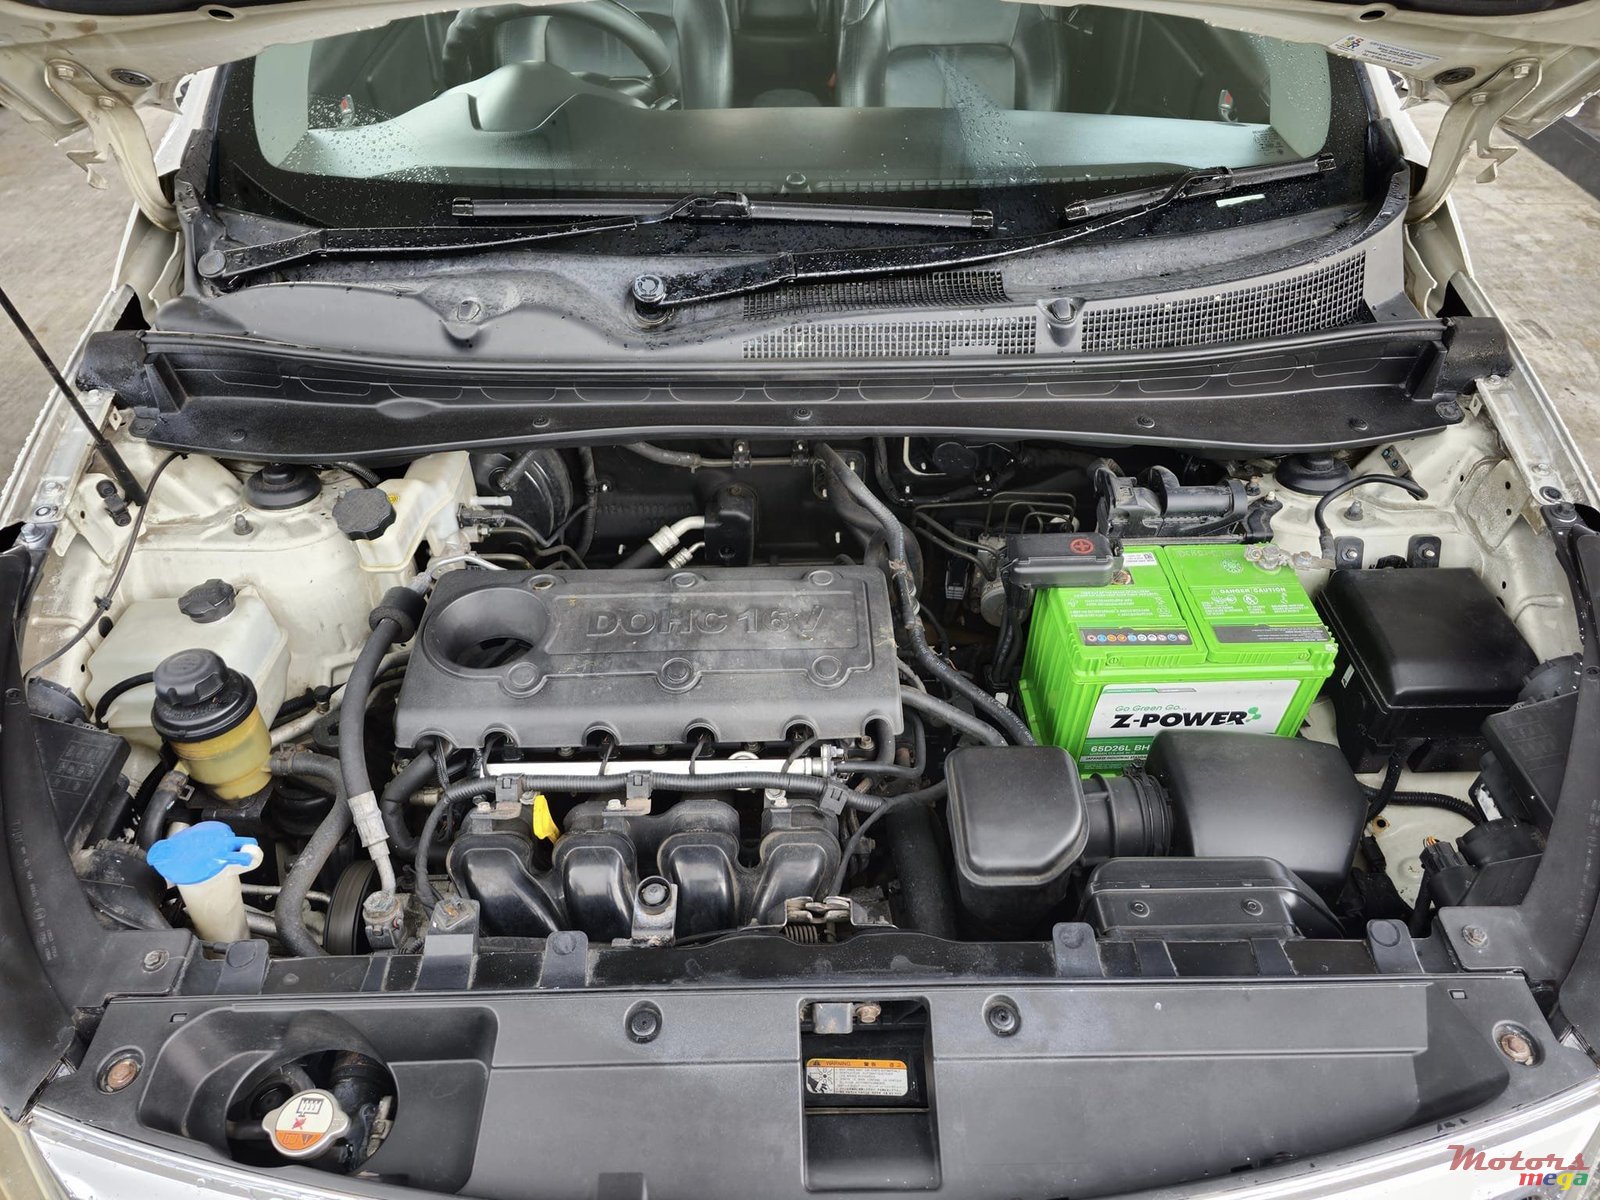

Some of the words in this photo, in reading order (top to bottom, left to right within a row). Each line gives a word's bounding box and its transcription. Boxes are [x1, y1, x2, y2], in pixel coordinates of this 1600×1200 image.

[587, 608, 728, 637] DOHC
[737, 604, 825, 636] 16V
[1132, 704, 1162, 712] Green
[1110, 711, 1248, 728] Z-POWER
[1090, 745, 1131, 753] 65D26L
